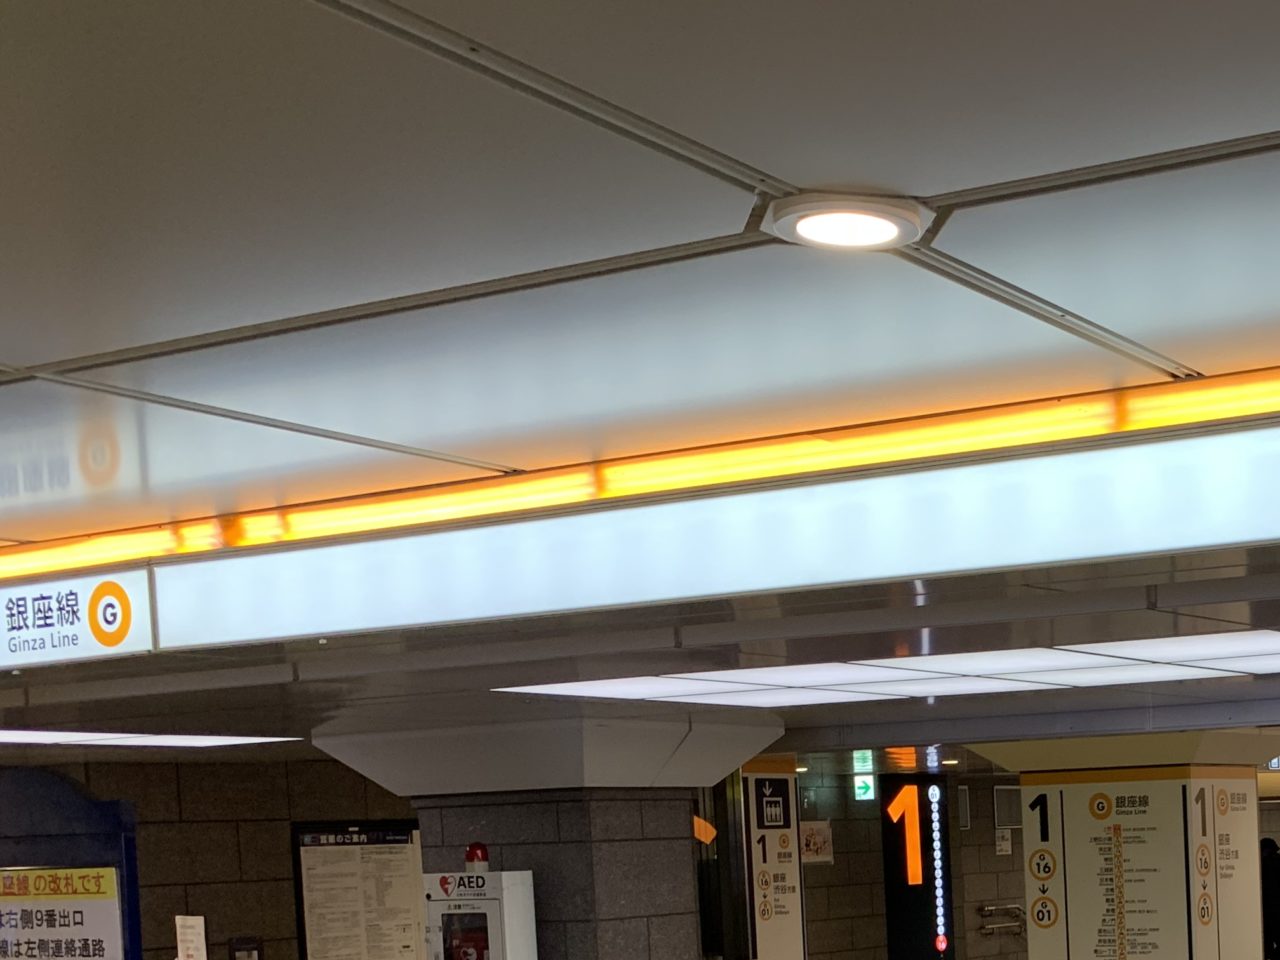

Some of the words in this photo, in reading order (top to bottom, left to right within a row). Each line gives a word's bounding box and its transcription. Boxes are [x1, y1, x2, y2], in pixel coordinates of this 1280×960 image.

[5, 590, 81, 632] 銀座線
[103, 602, 117, 625] G
[8, 635, 46, 653] Ginza
[51, 632, 79, 649] Line
[1096, 801, 1105, 811] G
[1115, 795, 1149, 808] 銀座線
[1028, 793, 1049, 842] 1
[1194, 787, 1207, 837] 1
[888, 785, 922, 885] 1
[757, 834, 767, 864] 1
[1036, 862, 1051, 874] 16
[1200, 858, 1208, 869] 16
[457, 875, 486, 888] AED
[760, 878, 769, 886] 16
[1041, 901, 1047, 909] G
[761, 908, 769, 916] 01
[1036, 910, 1051, 921] 01
[1201, 907, 1209, 918] 01
